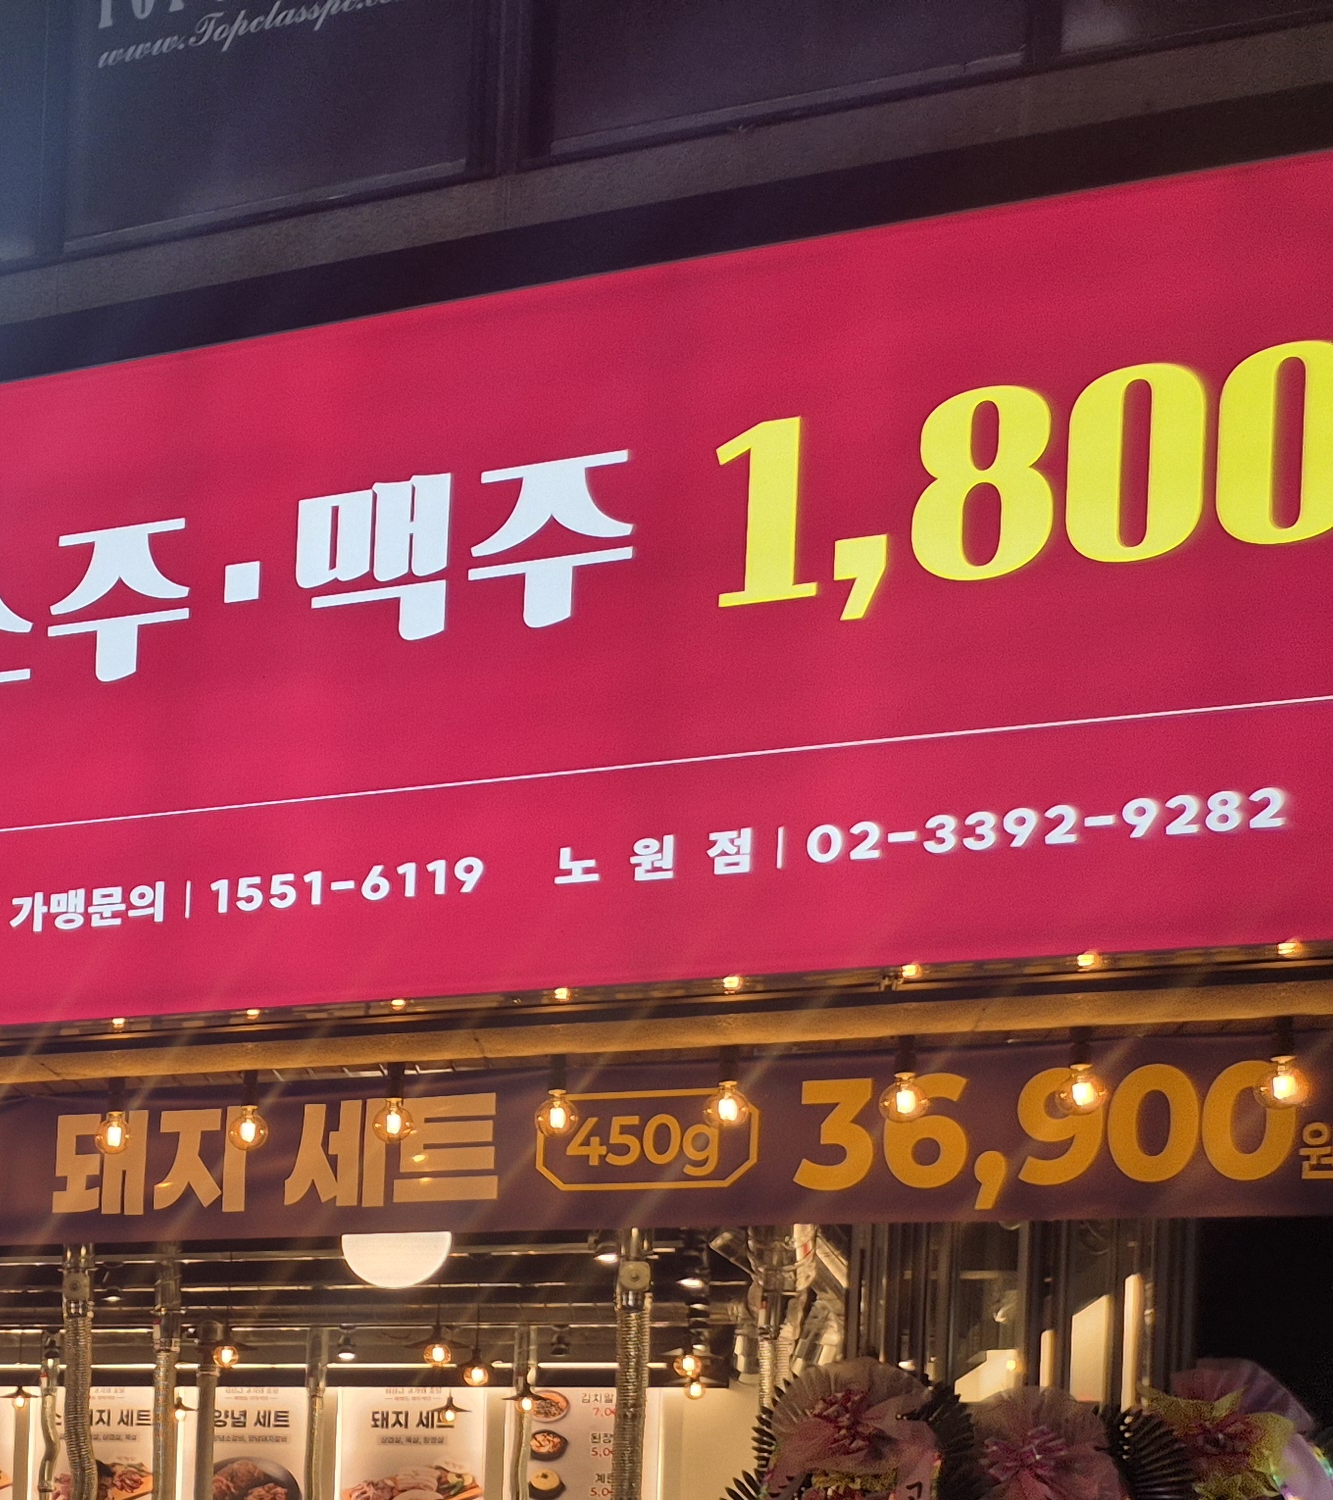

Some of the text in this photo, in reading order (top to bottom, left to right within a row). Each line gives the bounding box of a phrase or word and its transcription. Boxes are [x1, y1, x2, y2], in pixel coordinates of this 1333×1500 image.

[714, 339, 1333, 622] 1,800
[805, 785, 1288, 866] 02-3392-9282
[9, 852, 487, 935] 가맹문의 1551-6119
[53, 1104, 248, 1216] 돼지
[285, 1092, 498, 1211] 세트
[565, 1112, 720, 1178] 450g
[117, 1409, 154, 1427] 세트
[254, 1409, 291, 1428] 세트
[371, 1410, 409, 1429] 돼지
